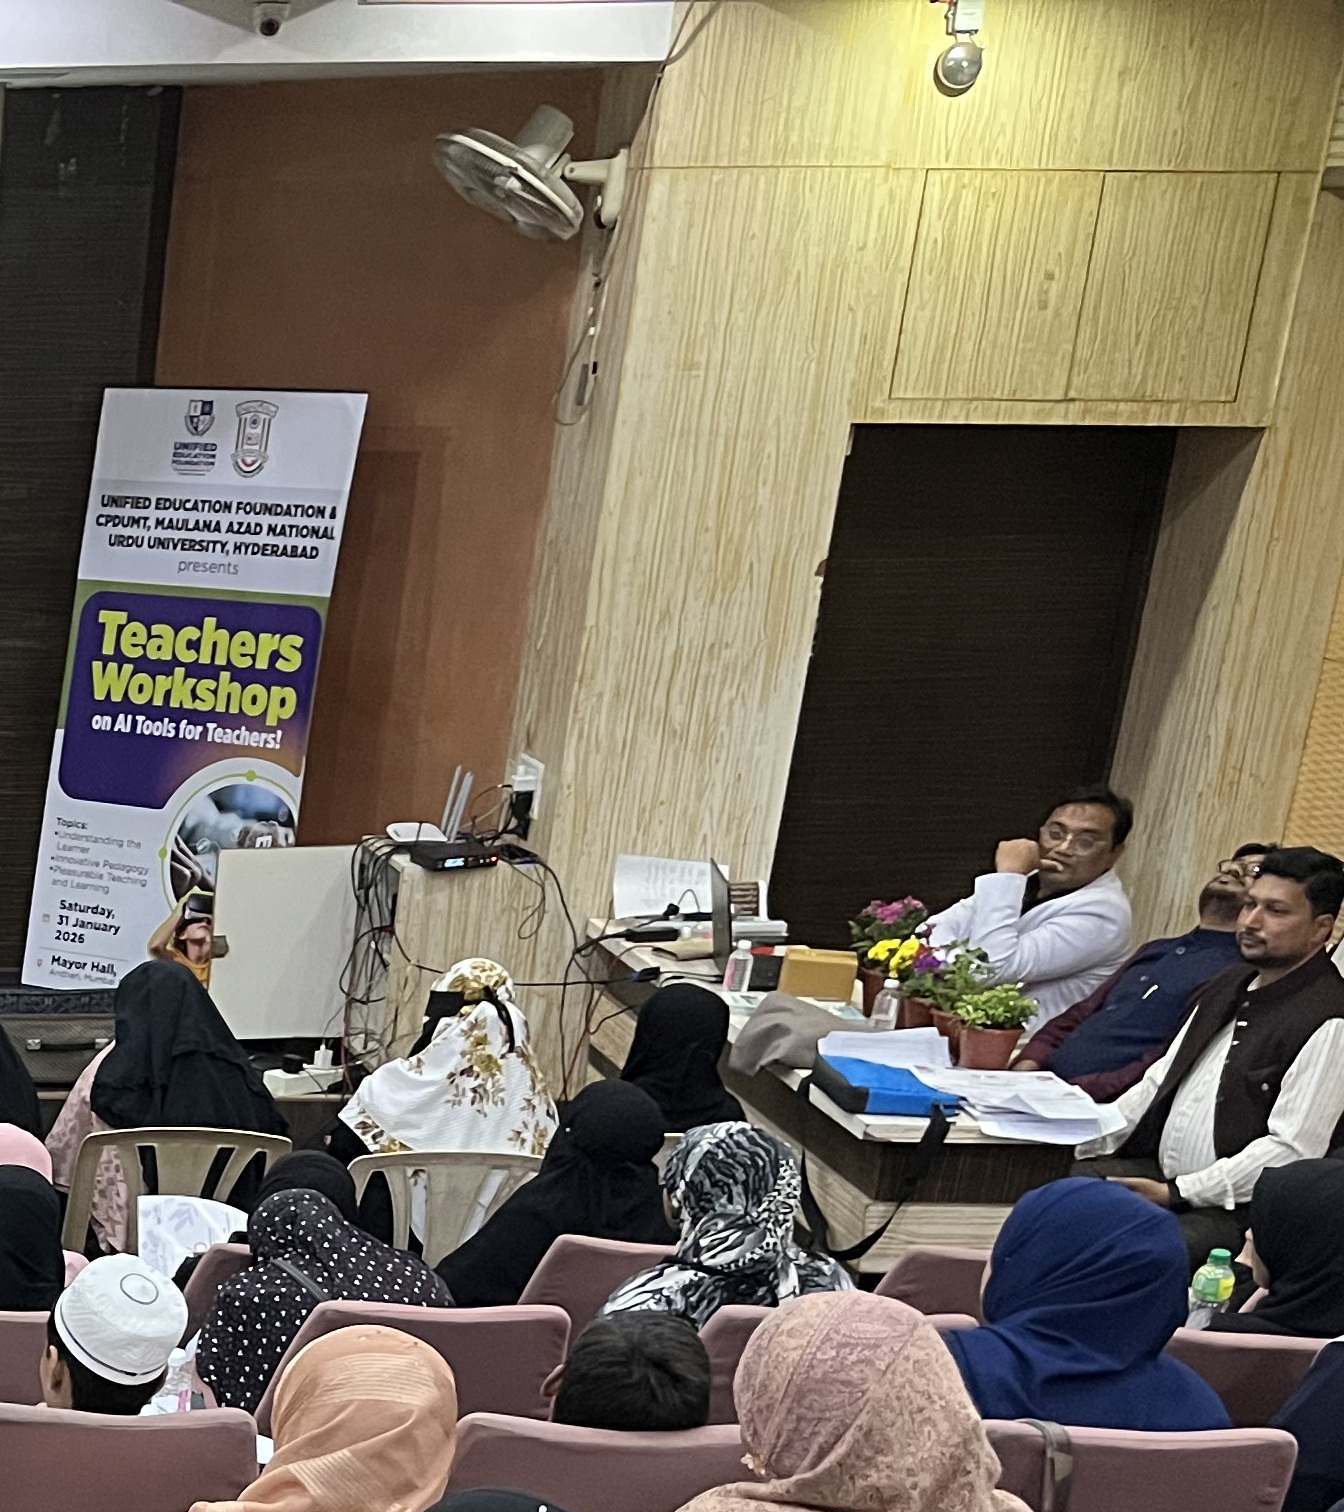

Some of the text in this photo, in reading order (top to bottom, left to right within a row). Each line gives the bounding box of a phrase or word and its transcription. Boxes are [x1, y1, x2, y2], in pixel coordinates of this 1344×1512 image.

[173, 442, 217, 452] UNIFIED
[100, 494, 152, 510] UNIFIED
[154, 497, 233, 514] EDUCATION
[235, 501, 329, 518] FOUNDATION
[96, 514, 335, 540] CPDUMT, MAULANA AZAD NATIONAL
[108, 534, 319, 560] URDU UNIVERSITY, HYDERABAD
[177, 558, 239, 575] presents
[98, 610, 304, 673] Teachers
[92, 660, 298, 726] Workshop
[91, 713, 282, 749] on AI Tools for Teachers!
[56, 841, 90, 854] Learner
[58, 831, 142, 849] Understanding the
[102, 859, 150, 876] Pedagogy
[51, 878, 110, 895] and Learning
[107, 871, 148, 888] Teaching
[59, 899, 115, 919] Saturday,
[57, 914, 121, 936] 31 January
[54, 929, 85, 944] 2026
[51, 954, 117, 978] Mayor Hall,
